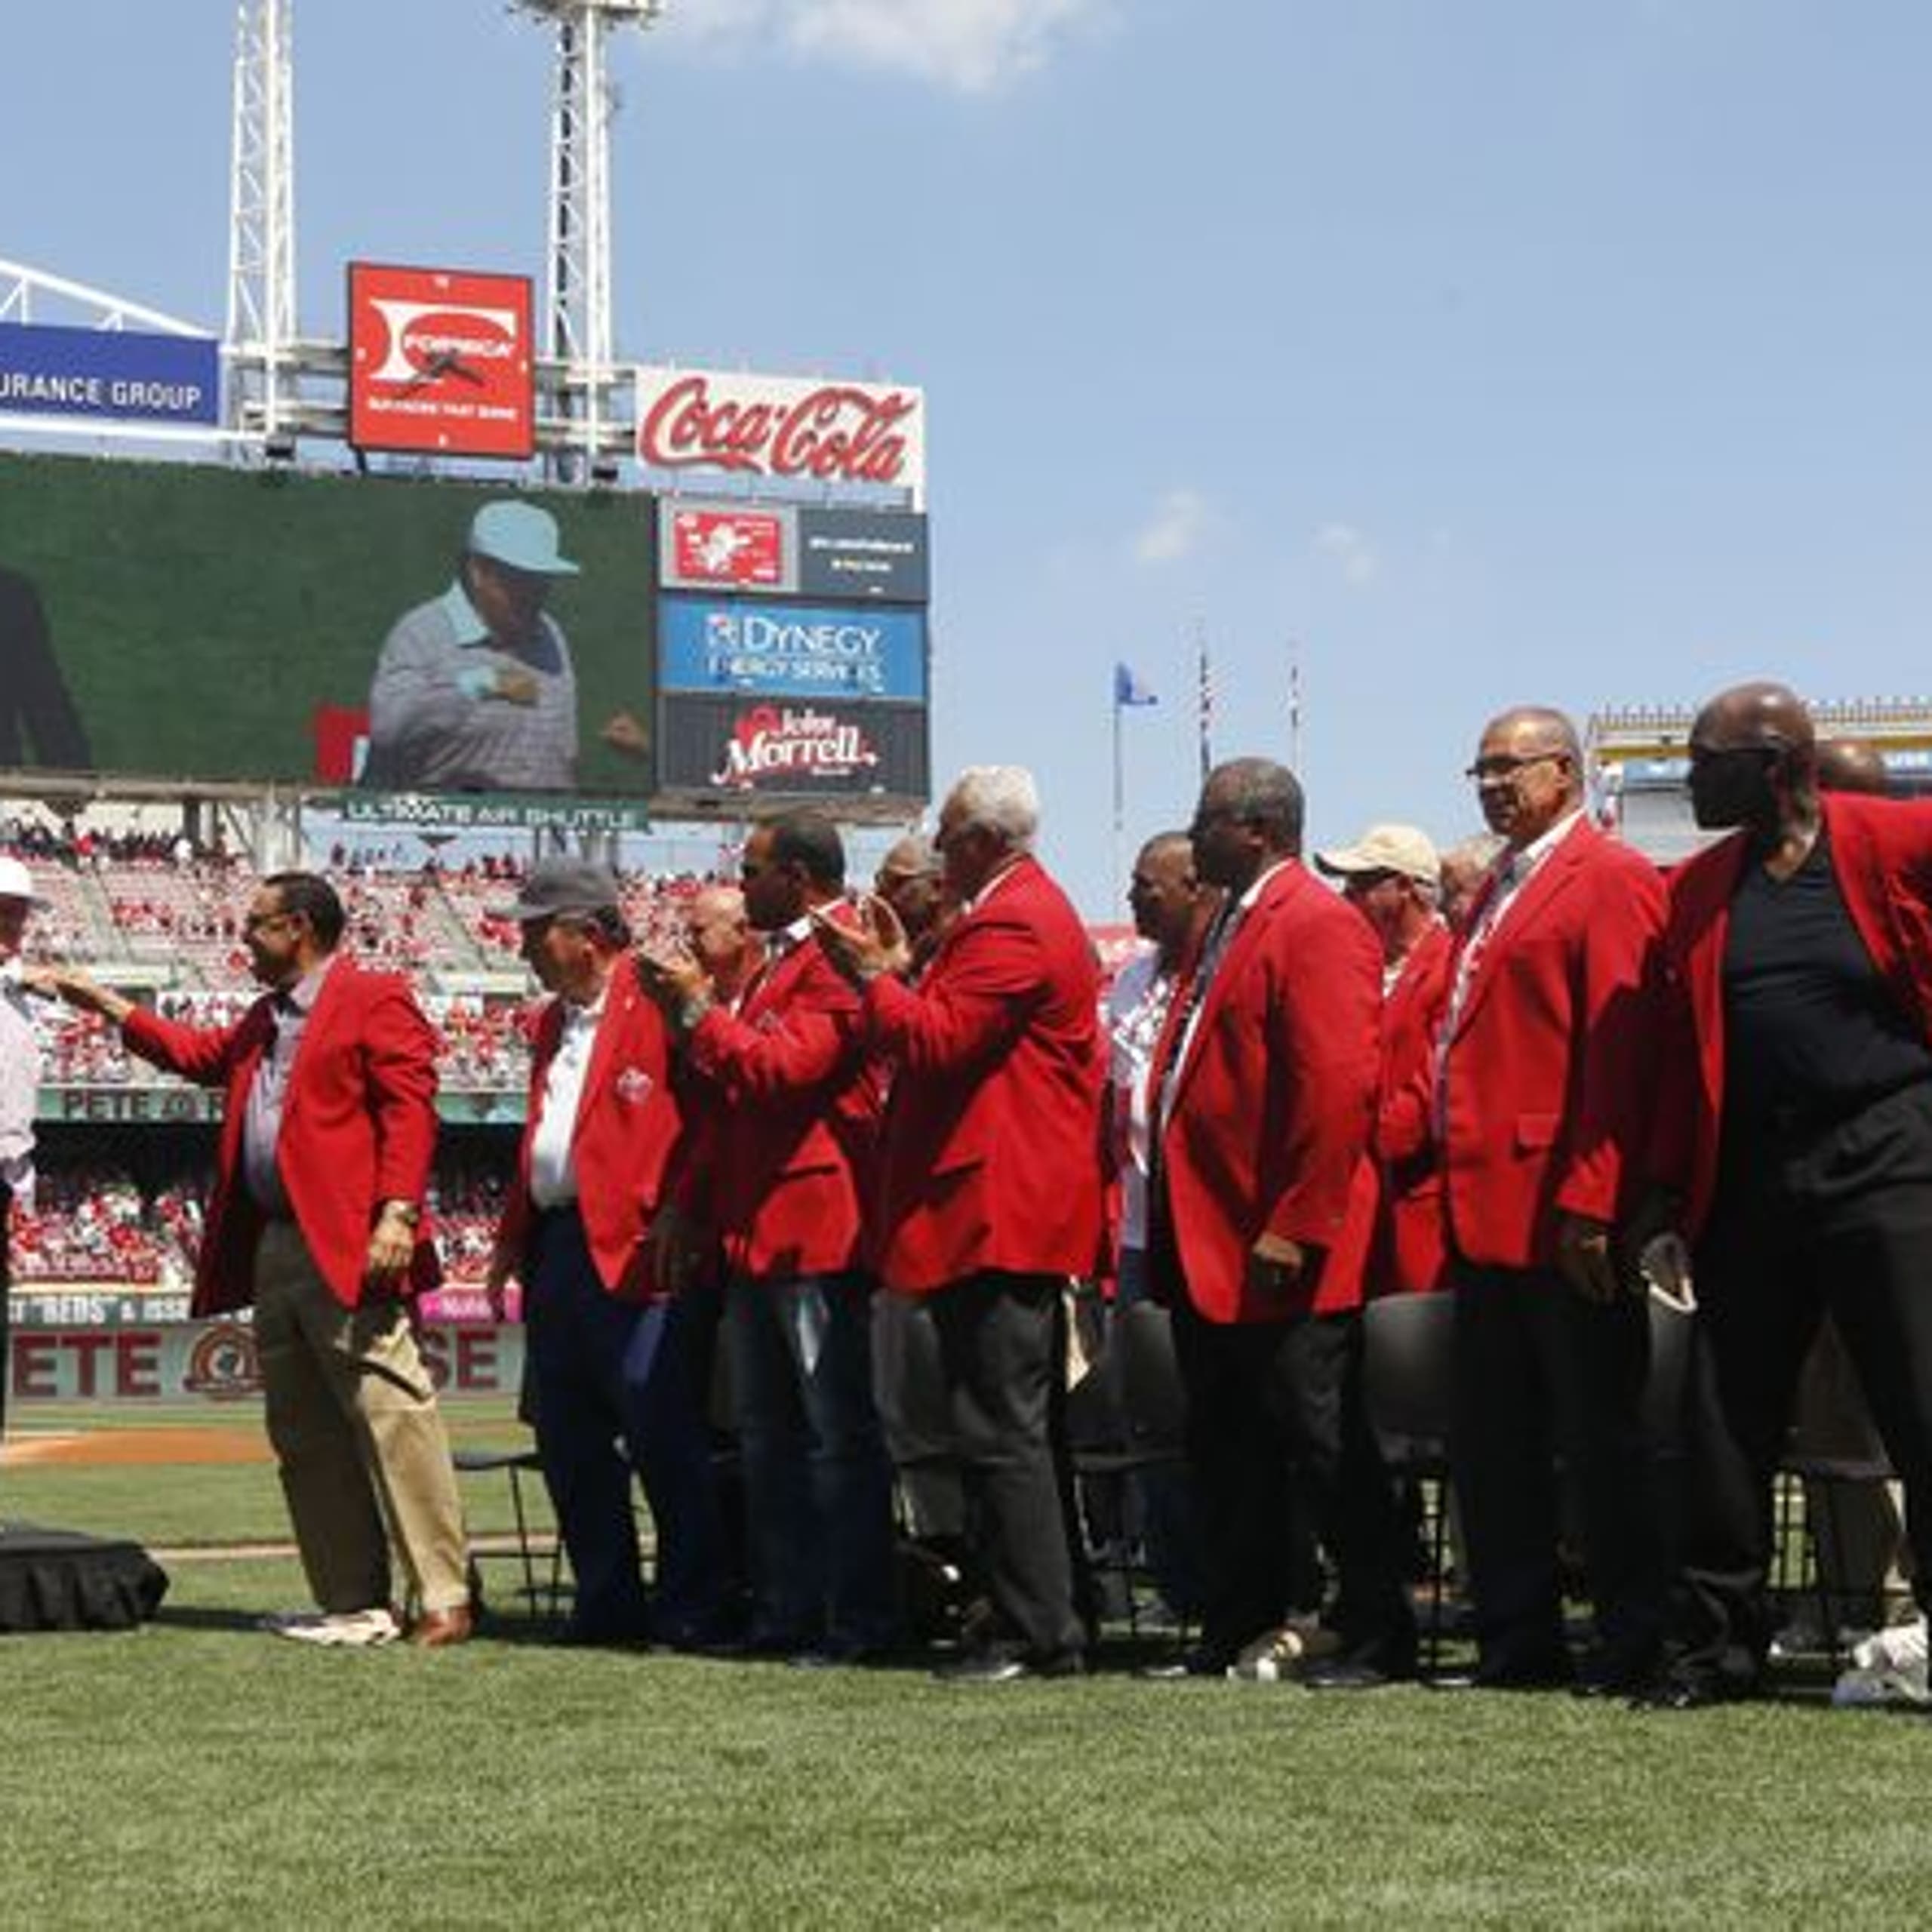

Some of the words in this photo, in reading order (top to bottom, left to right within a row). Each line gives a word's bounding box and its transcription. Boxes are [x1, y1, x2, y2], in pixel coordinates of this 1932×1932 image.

[112, 380, 202, 410] GROUP
[743, 615, 881, 654] DYNEGY
[709, 724, 878, 785] Morrell
